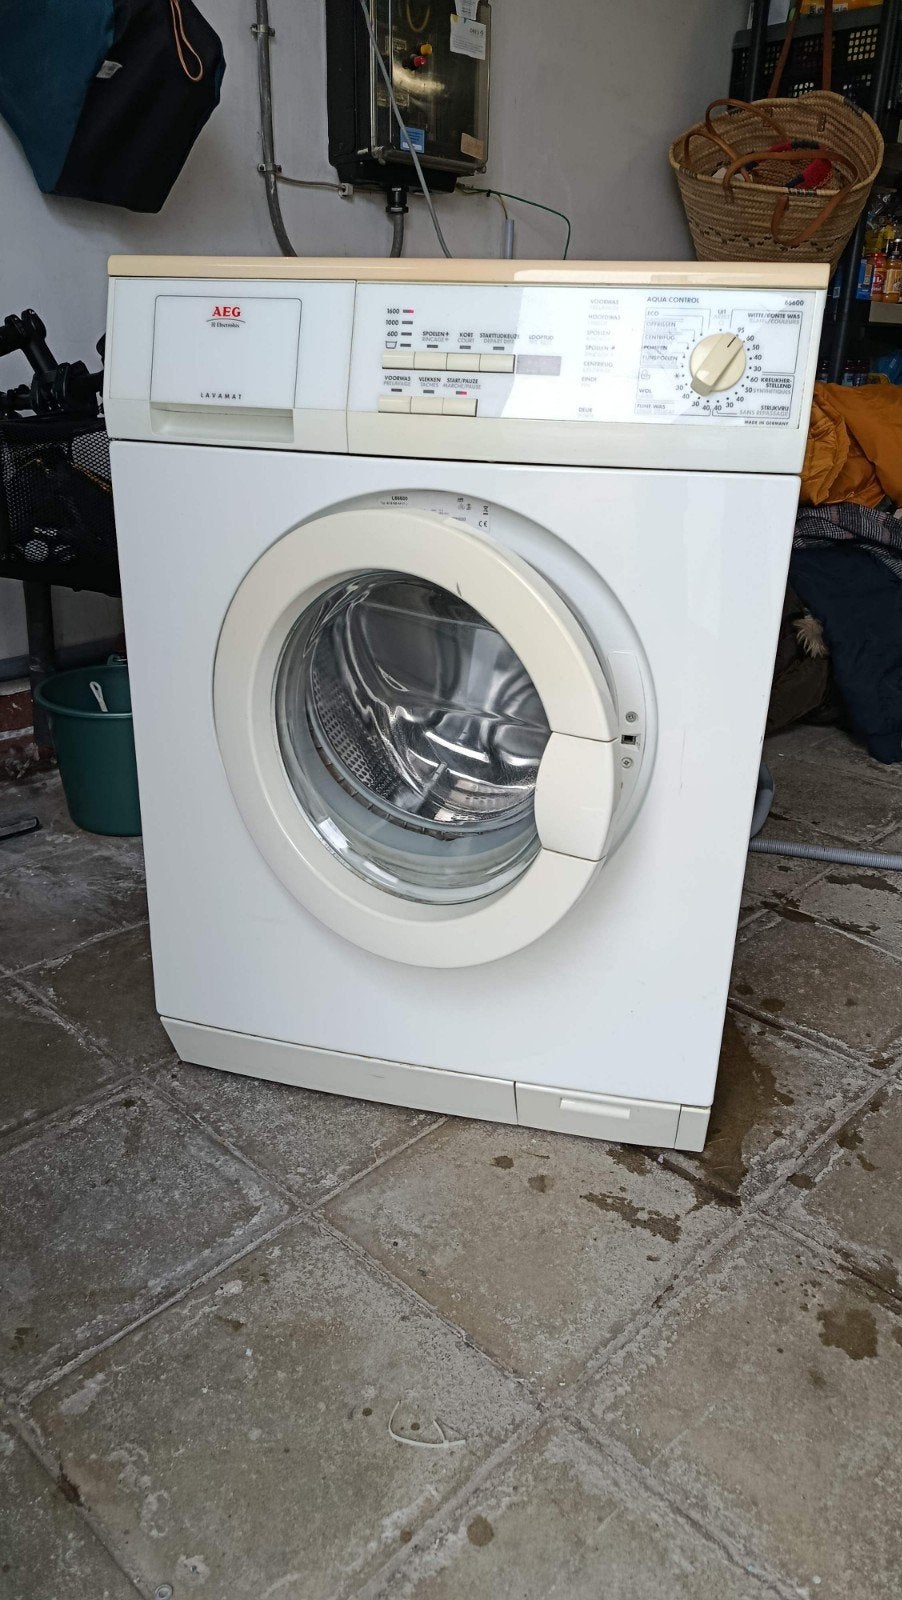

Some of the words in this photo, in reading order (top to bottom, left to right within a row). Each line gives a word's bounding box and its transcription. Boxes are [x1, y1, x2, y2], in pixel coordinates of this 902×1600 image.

[646, 296, 667, 304] AQUA
[668, 296, 700, 304] CONTROL
[212, 306, 242, 318] AEG
[200, 392, 242, 400] LAVAMAT
